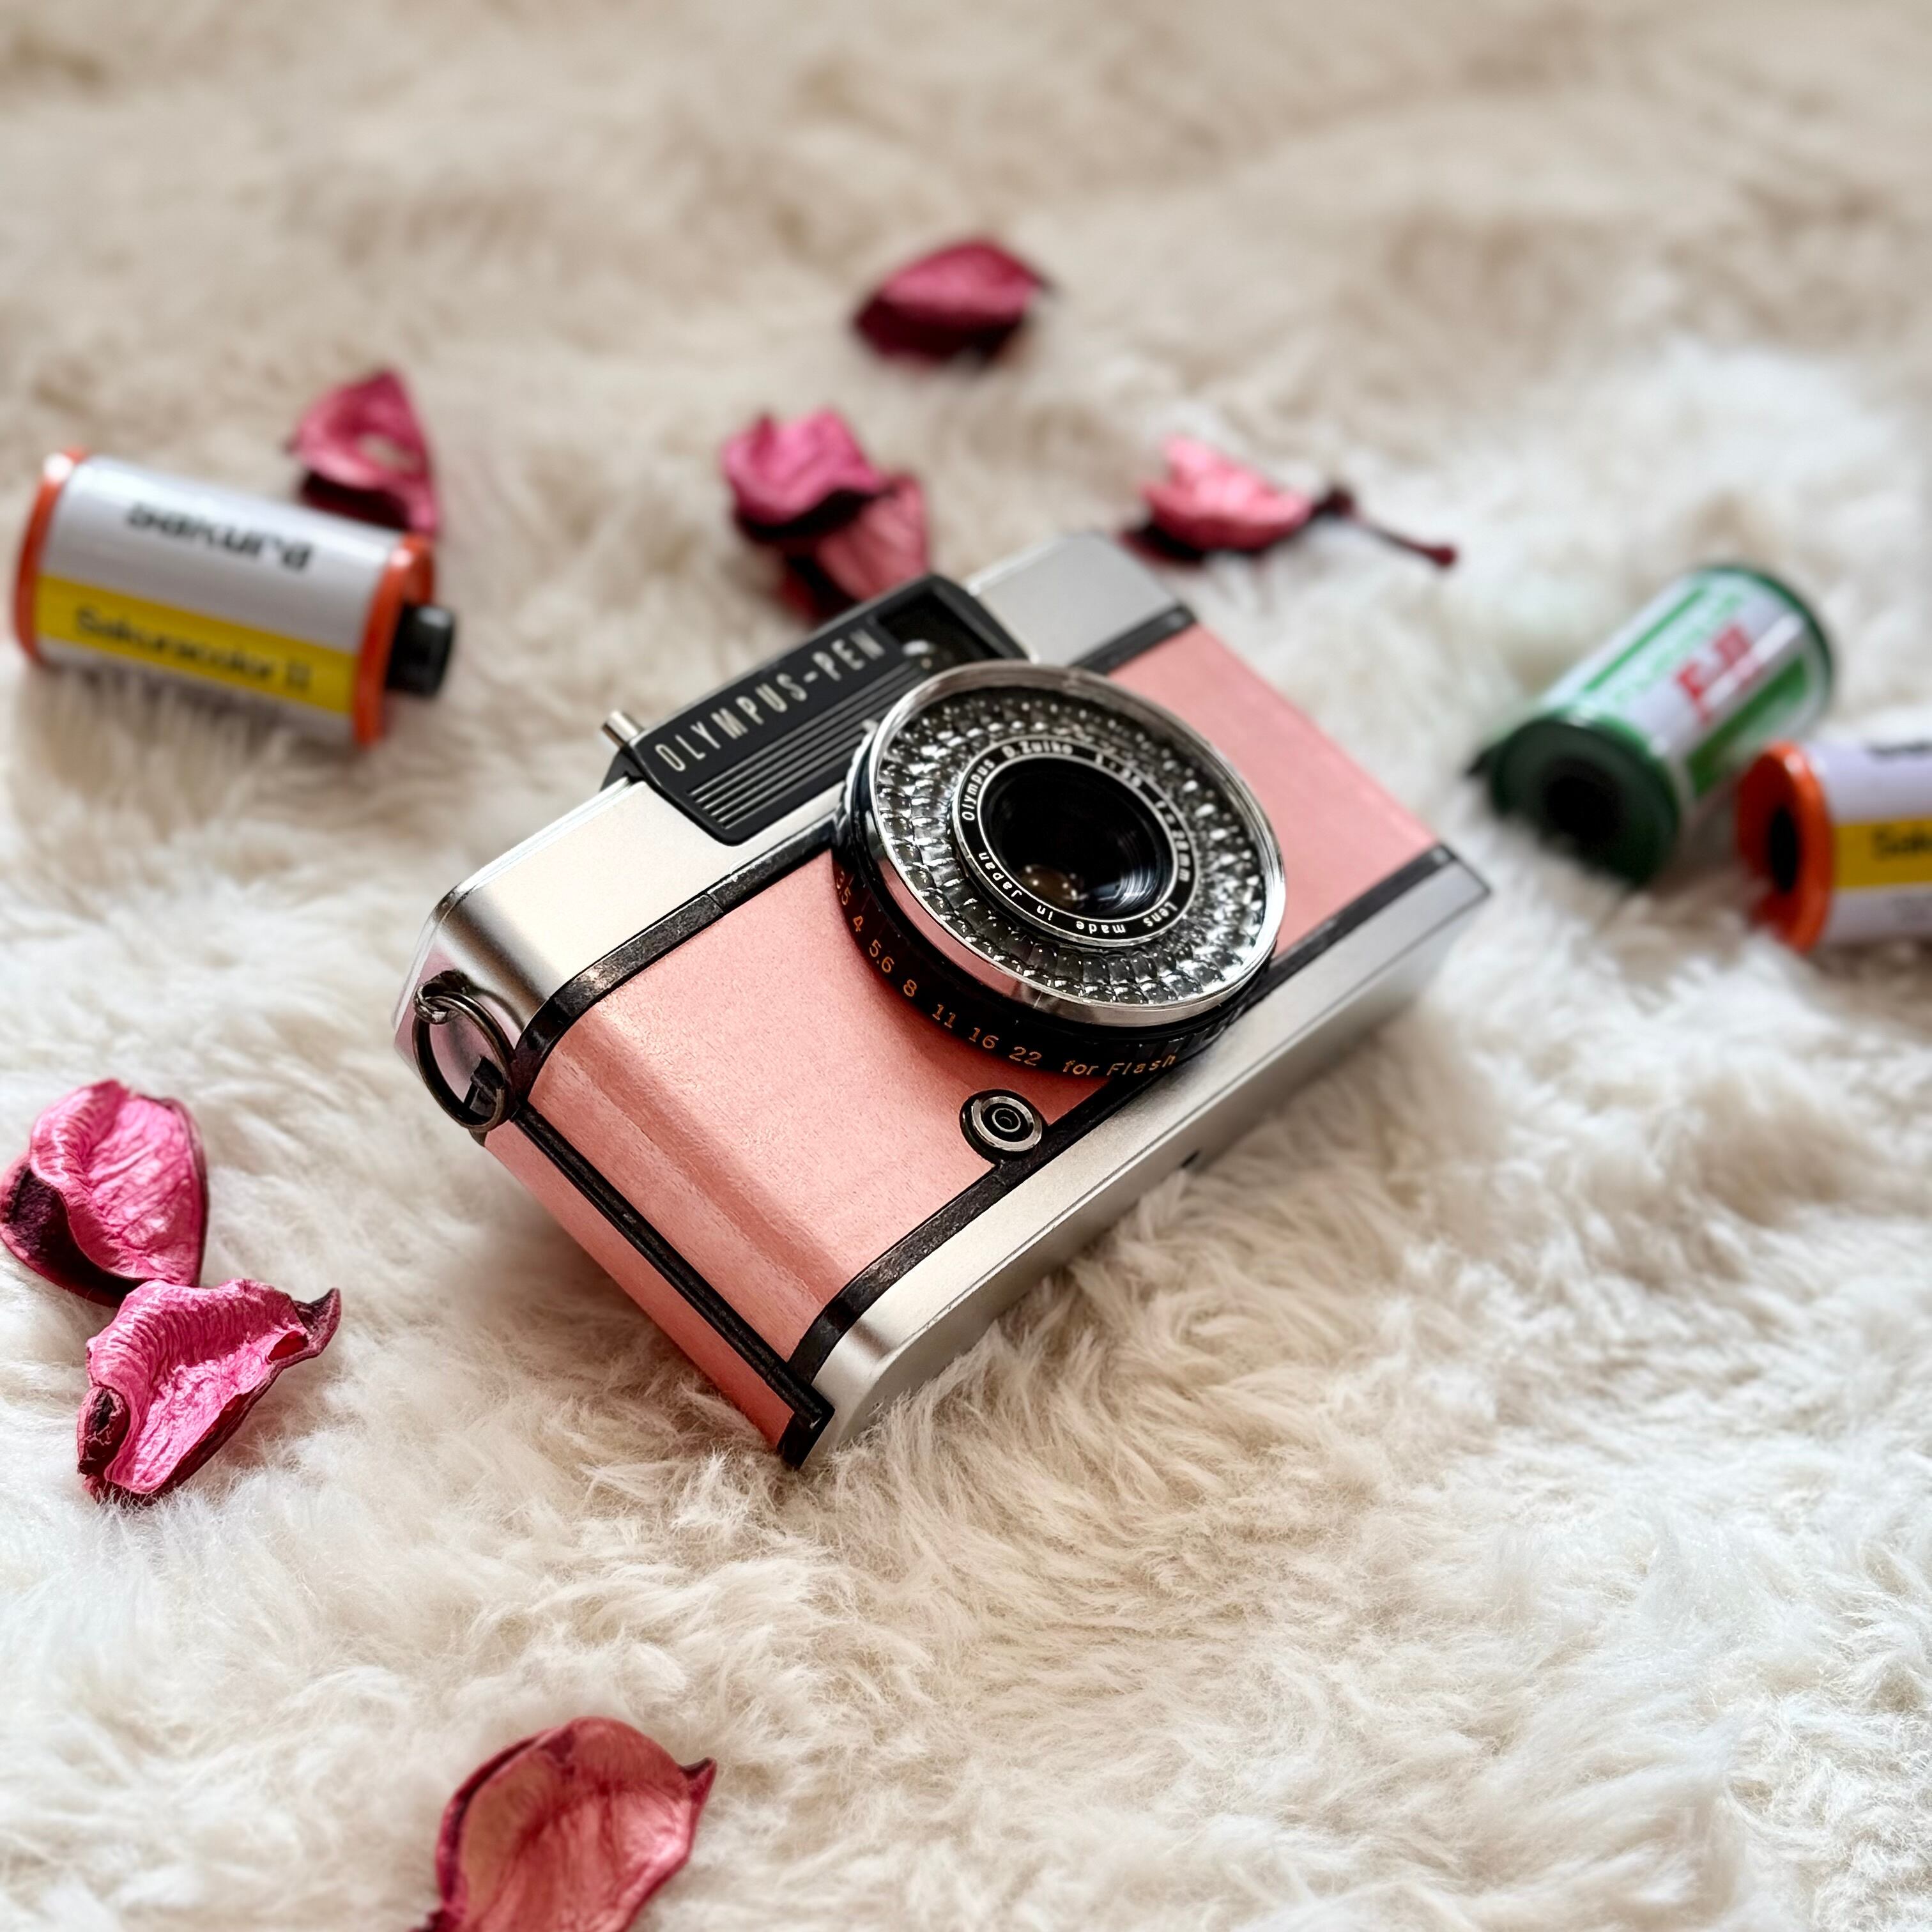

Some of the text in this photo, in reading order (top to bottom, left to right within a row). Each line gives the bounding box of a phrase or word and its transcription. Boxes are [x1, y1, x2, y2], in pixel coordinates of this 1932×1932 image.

[654, 629, 885, 772] OLYMPUS-PEN
[961, 758, 996, 822] Olympus
[977, 851, 1022, 898] Japan
[1036, 905, 1054, 921] in
[1075, 921, 1127, 935] made
[1142, 901, 1179, 928] Lens
[853, 916, 863, 932] 4
[869, 939, 895, 974] 5.6
[903, 979, 918, 997] 8
[931, 1004, 956, 1029] 11
[968, 1027, 1000, 1049] 16
[1008, 1046, 1043, 1067] 22
[1062, 1059, 1100, 1076] for
[1106, 1054, 1177, 1077] Flash
